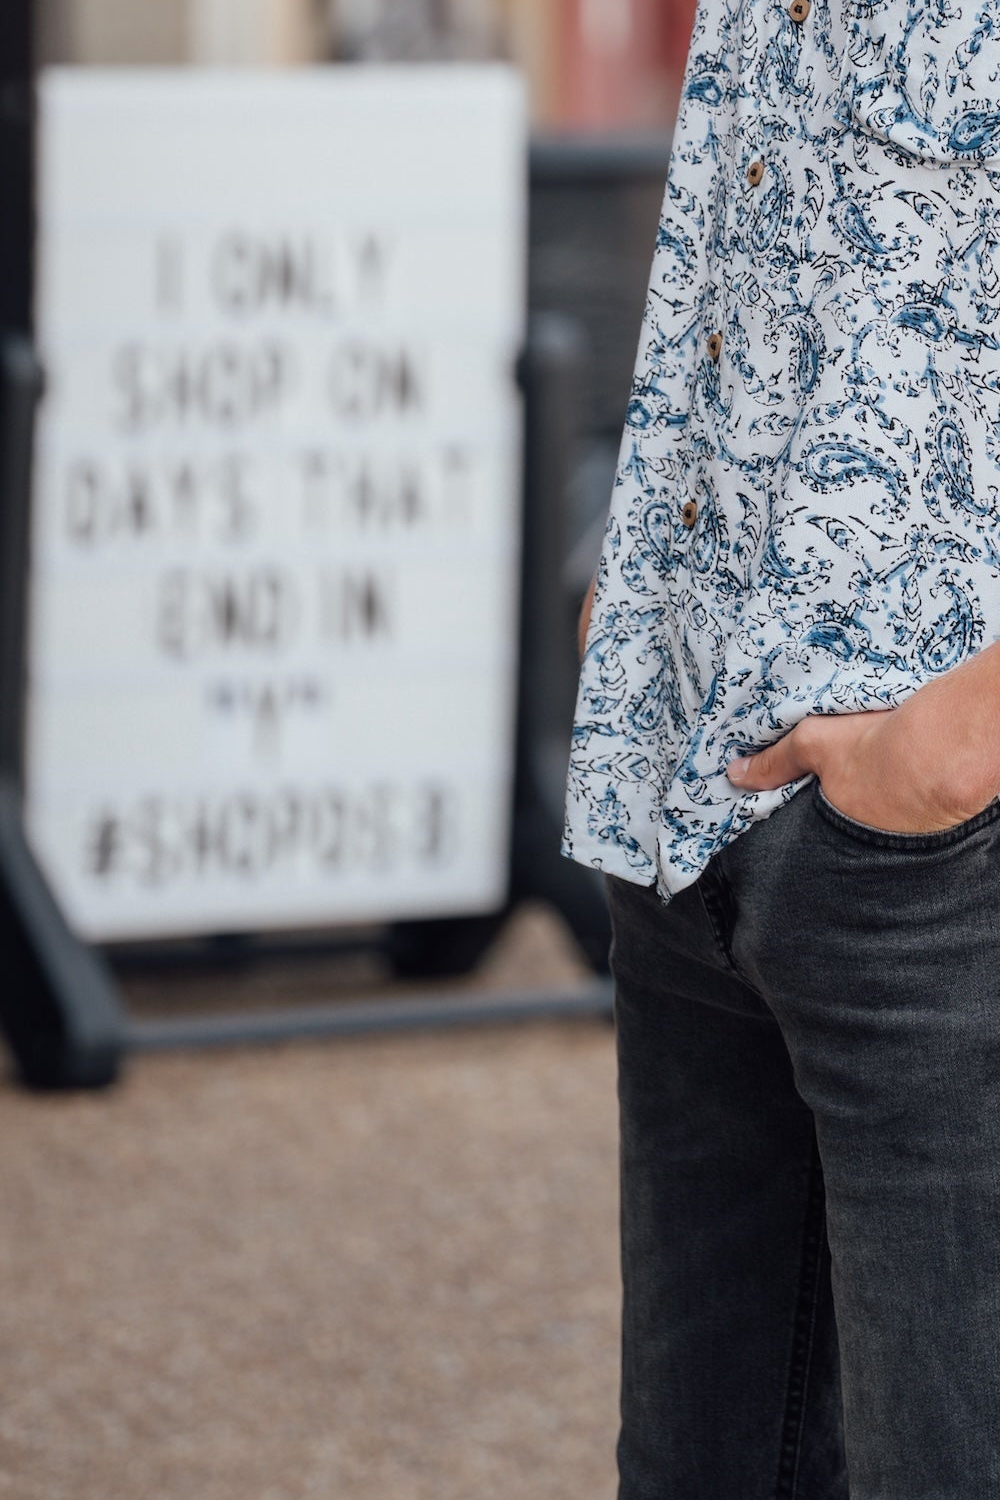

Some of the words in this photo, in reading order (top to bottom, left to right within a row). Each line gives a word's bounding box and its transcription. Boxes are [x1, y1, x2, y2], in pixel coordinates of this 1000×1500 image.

[212, 228, 393, 320] ONLY
[112, 338, 298, 436] SHOP
[331, 337, 426, 427] ON
[64, 455, 258, 553] DAYS
[295, 440, 476, 538] THAT
[155, 565, 297, 664] END
[323, 560, 393, 652] IN
